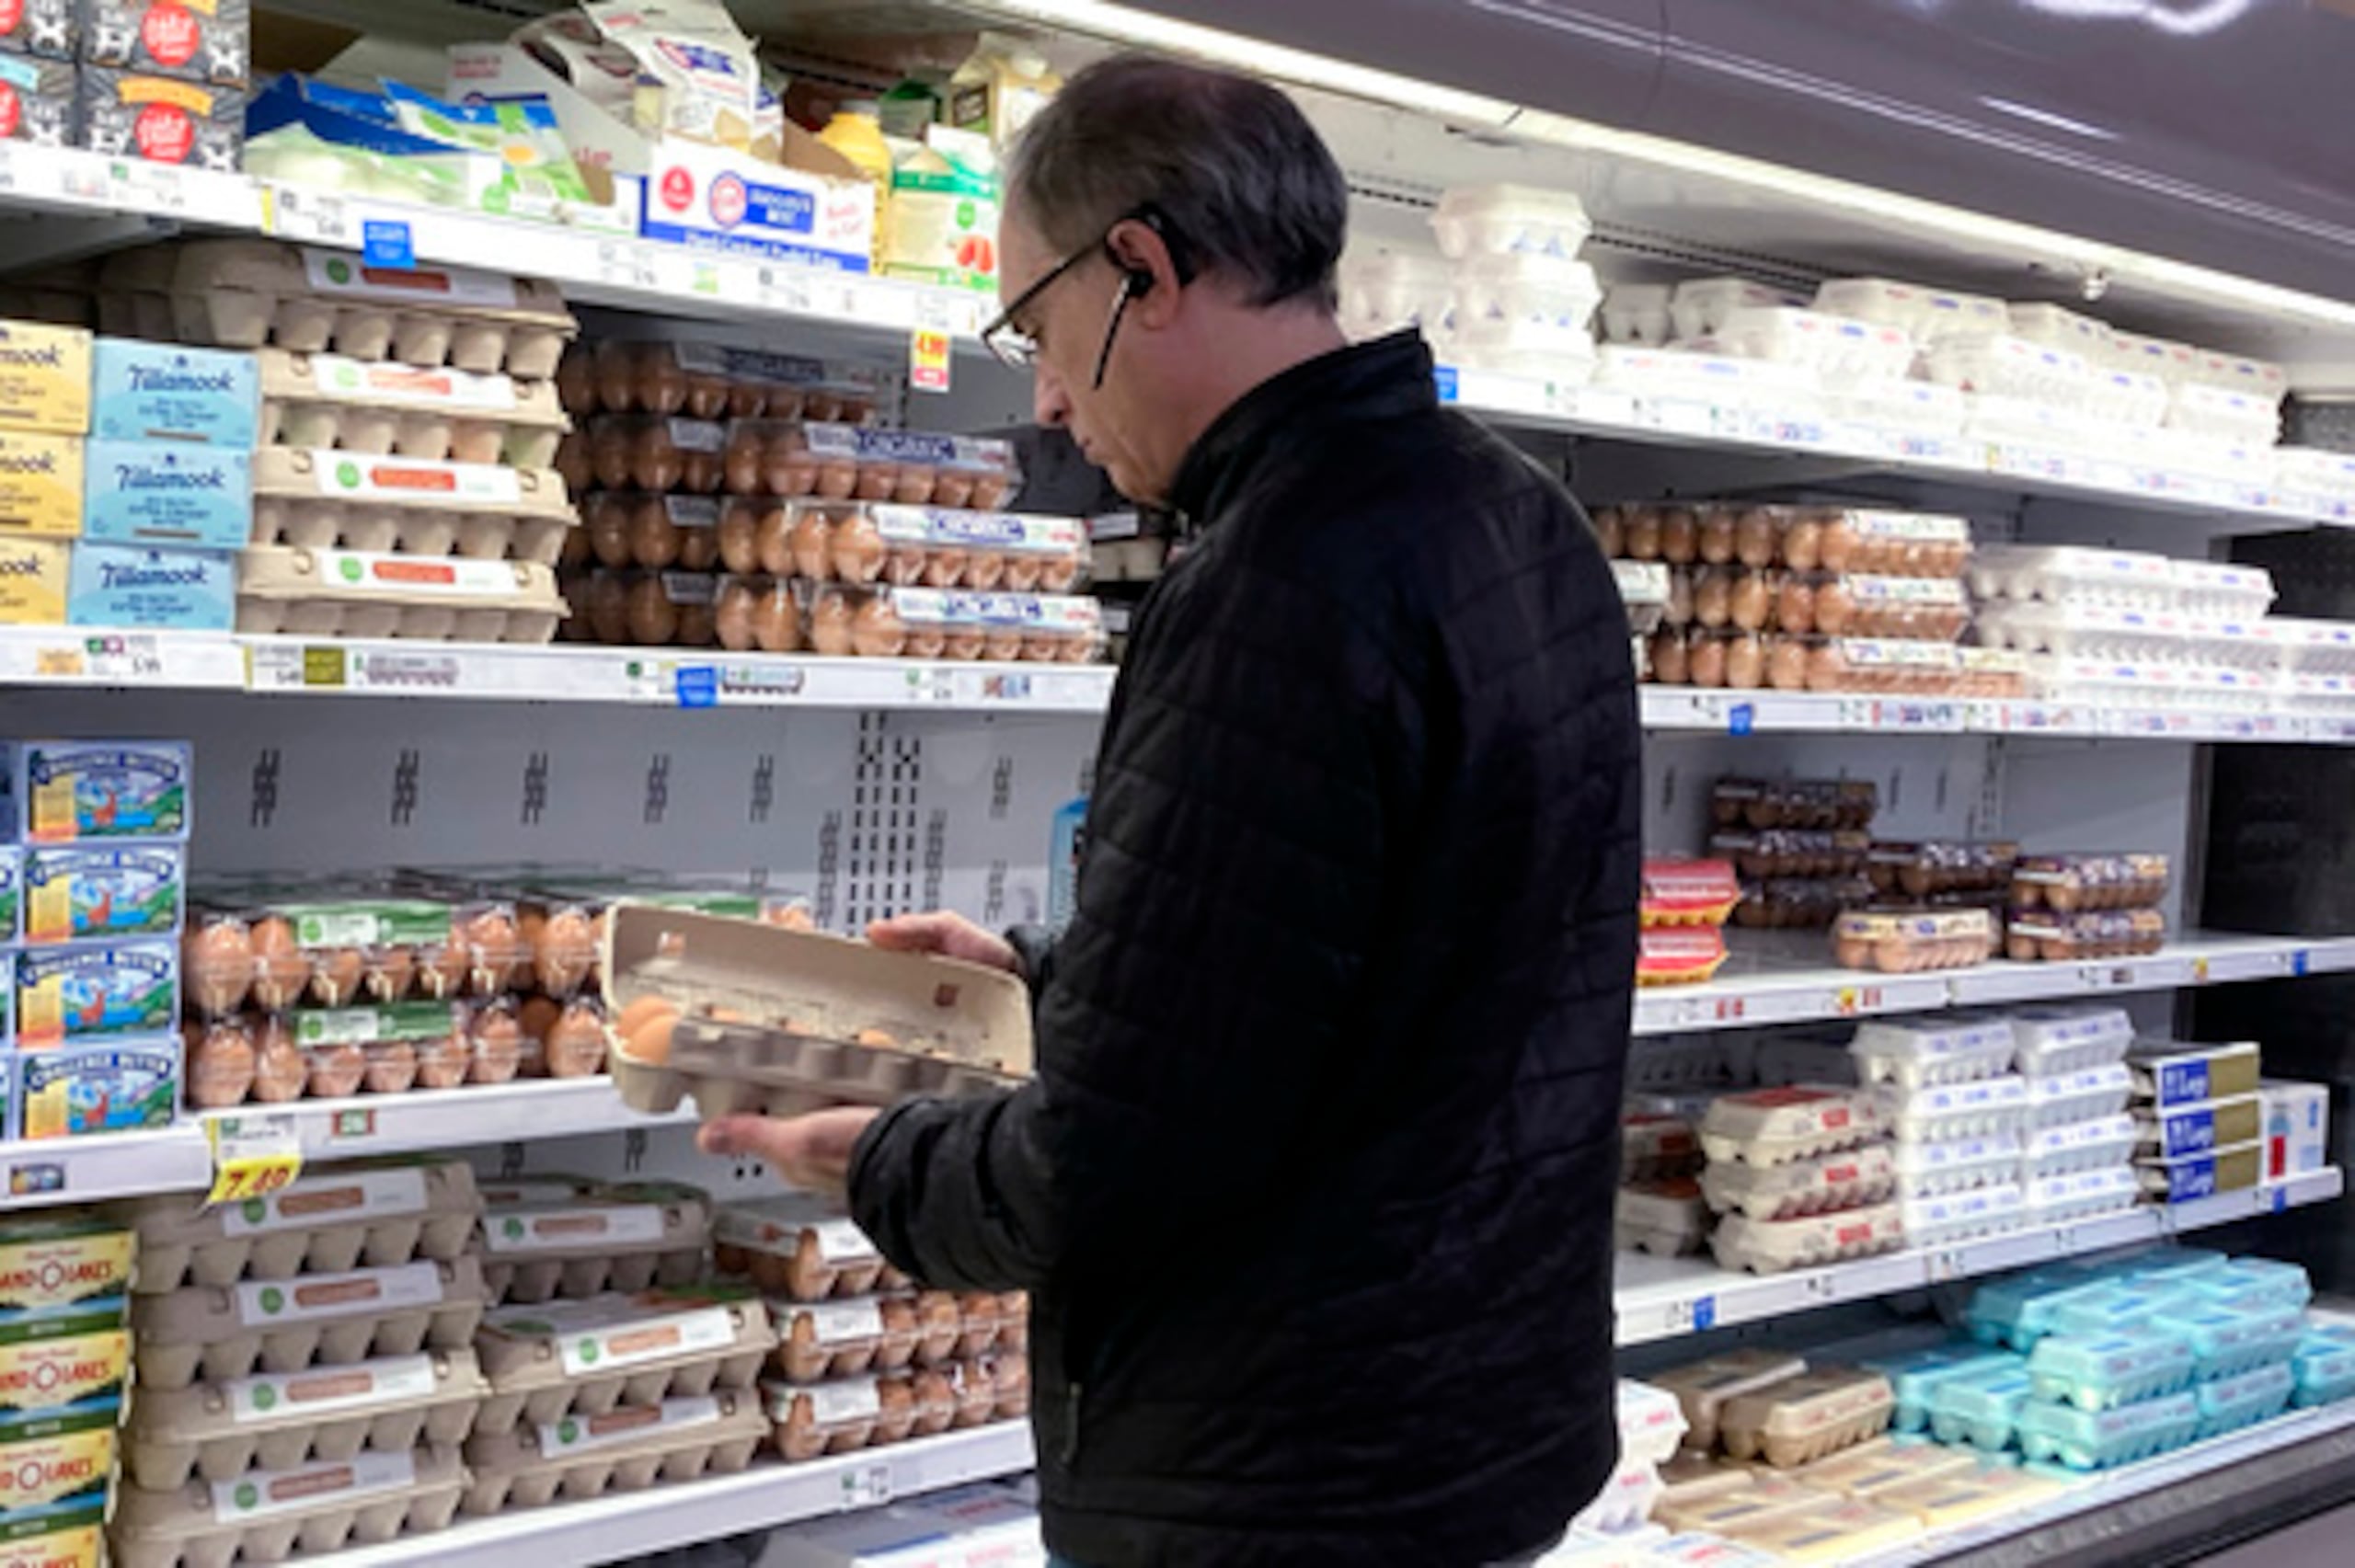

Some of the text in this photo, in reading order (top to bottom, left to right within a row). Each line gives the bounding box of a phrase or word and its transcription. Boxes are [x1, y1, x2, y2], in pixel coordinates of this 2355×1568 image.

[127, 363, 235, 391] Tillamook
[116, 464, 226, 492] Tillamook
[100, 561, 209, 589] Tillamook
[66, 1260, 114, 1283] LAKES
[63, 1357, 111, 1384] LAKES
[44, 1457, 93, 1482] LAKES
